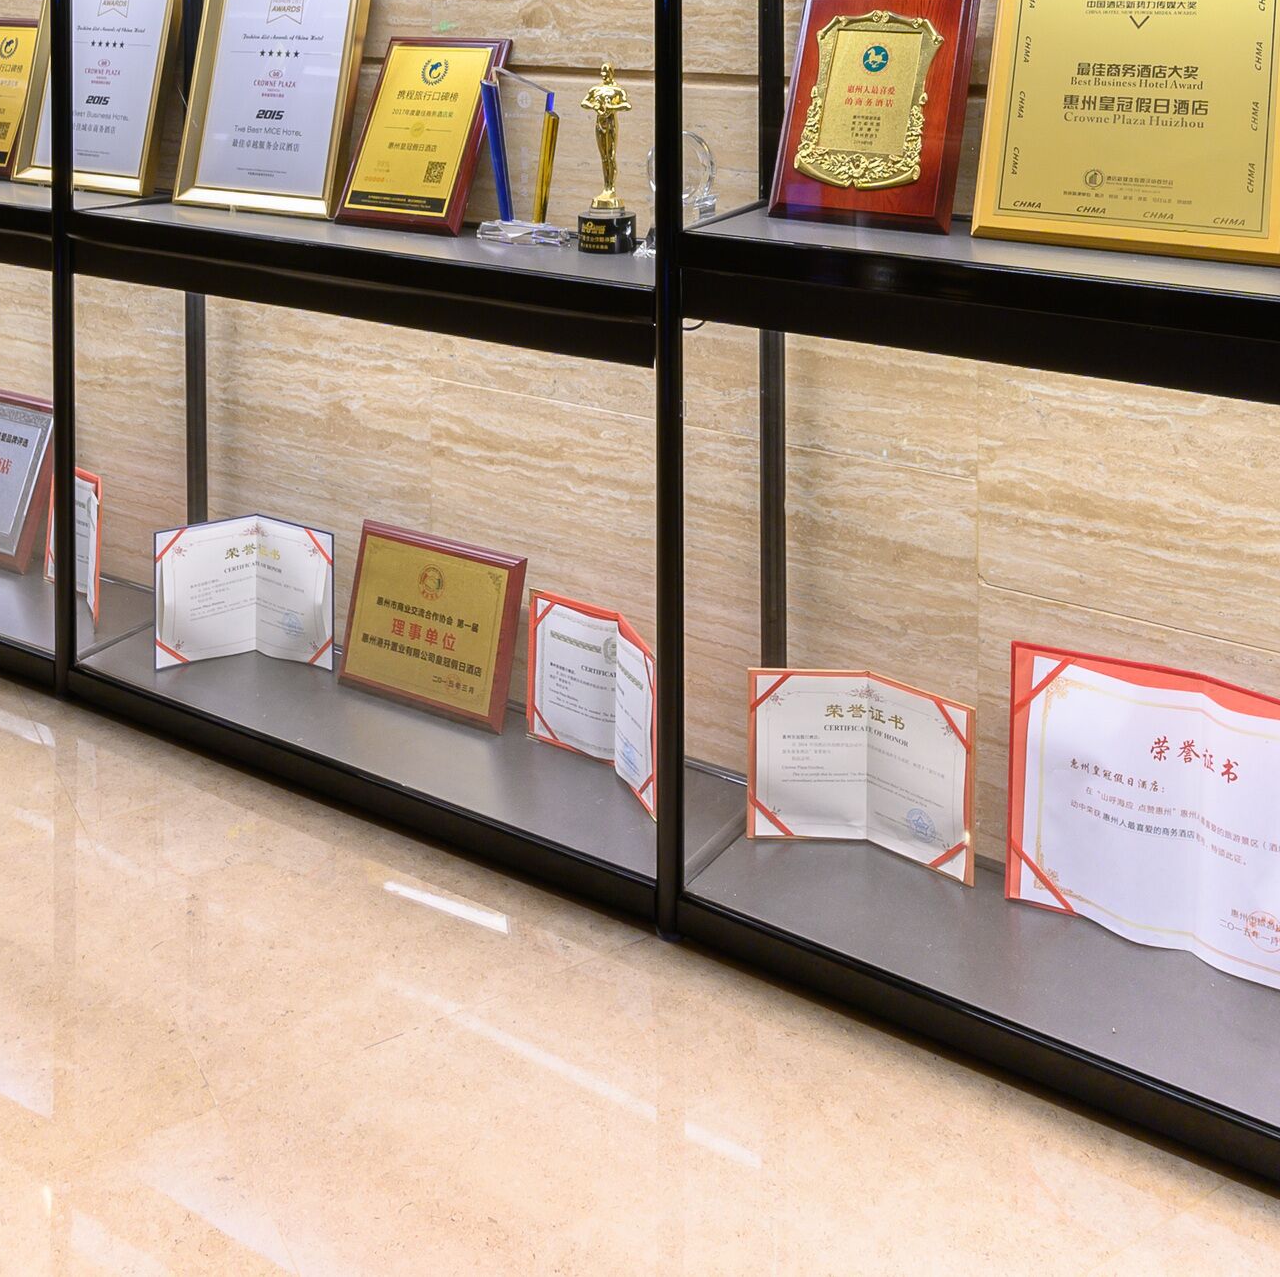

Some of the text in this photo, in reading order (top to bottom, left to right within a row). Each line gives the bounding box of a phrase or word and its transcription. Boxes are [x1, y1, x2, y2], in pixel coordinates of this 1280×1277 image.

[271, 5, 301, 13] AWARDS
[1086, 0, 1197, 9] 中国酒店新势力传媒大奖
[1023, 35, 1032, 63] CHMA
[1254, 40, 1263, 71] CHMA
[84, 67, 121, 76] CROWNE PLAZA
[1077, 62, 1199, 80] 最佳商务酒店大奖
[253, 79, 296, 88] CROWNE PLAZA
[847, 84, 895, 95] 惠州人最喜爱
[1070, 76, 1204, 90] Best Business Hotel Award
[86, 95, 110, 105] 2015
[396, 90, 459, 103] 携程旅行口碑榜
[844, 97, 894, 108] 的商务酒店
[1017, 90, 1026, 118] CHMA
[1063, 94, 1209, 116] 惠州皇冠假日酒店
[256, 109, 284, 120] 2015
[1063, 111, 1205, 129] Crowne Plaza Huizhou
[1250, 100, 1259, 132] CHMA
[264, 127, 281, 135] MICE
[232, 138, 300, 153] 最佳卓越服务会议酒店
[387, 142, 437, 153] 惠州皇冠假日酒店
[1011, 146, 1020, 175] CHMA
[1246, 162, 1256, 193] CHMA
[1013, 200, 1042, 209] CHMA
[1076, 205, 1107, 215] CHMA
[1142, 210, 1174, 220] CHMA
[1212, 217, 1246, 227] CHMA
[225, 543, 281, 561] 荣誉证书
[376, 596, 479, 634] 惠州市商业交流合作协会 第一届
[391, 617, 456, 652] 理事单位
[824, 703, 905, 731] 荣誉证书
[1150, 736, 1238, 784] 荣誉证书
